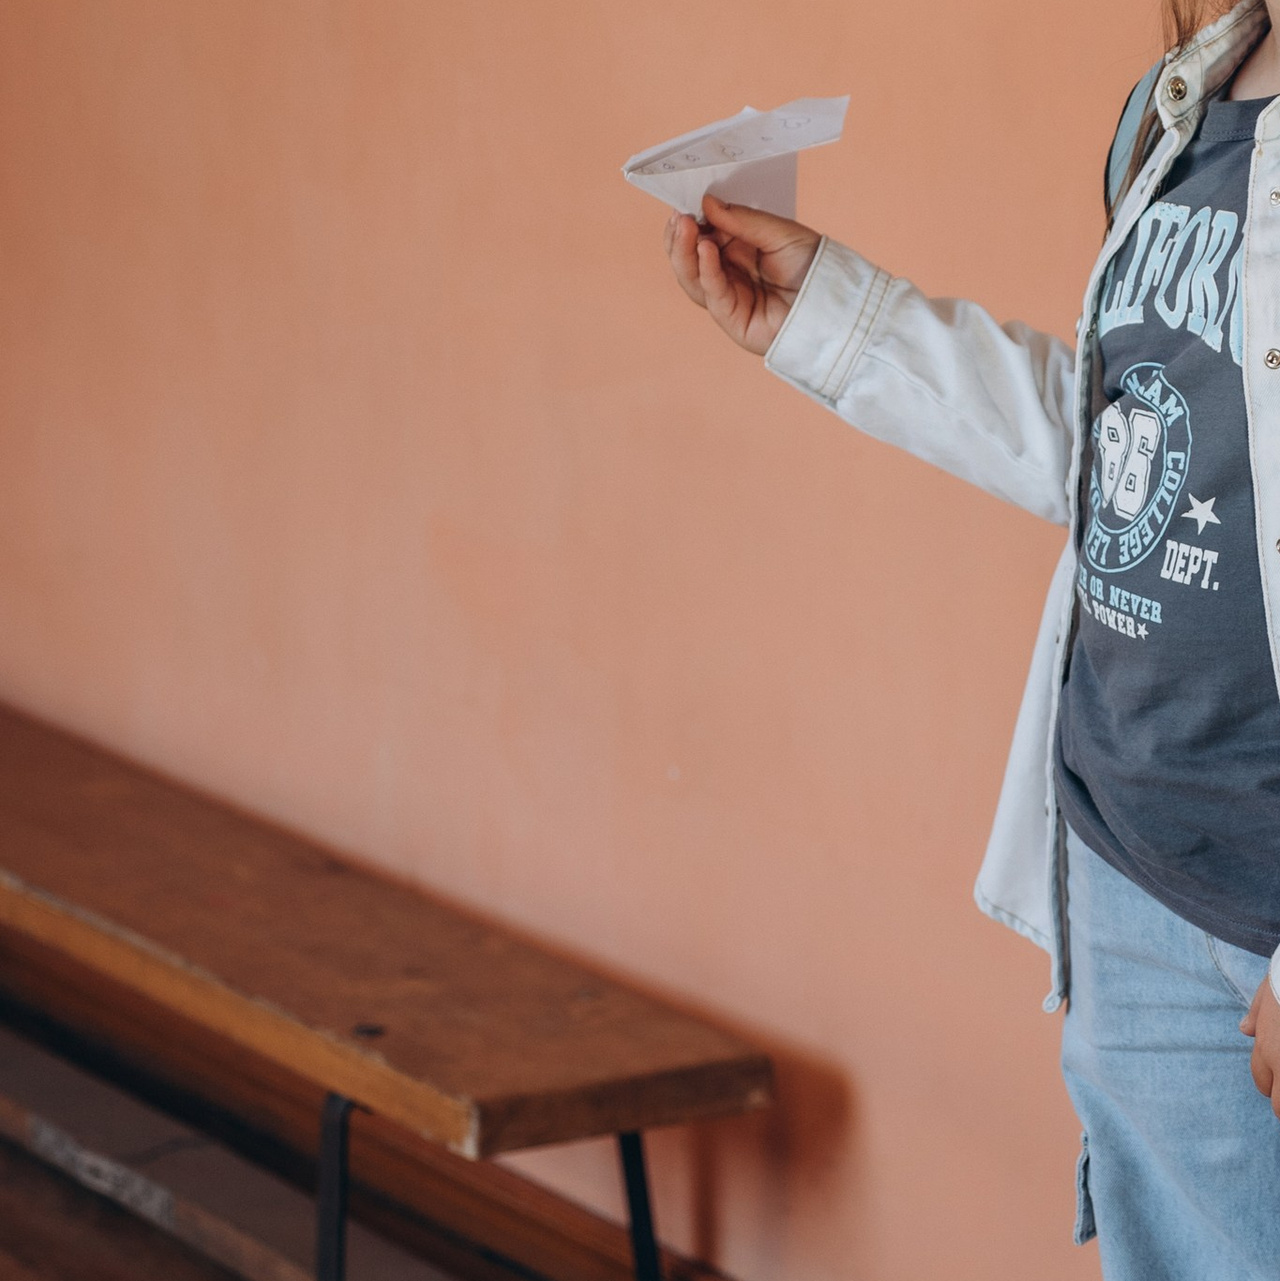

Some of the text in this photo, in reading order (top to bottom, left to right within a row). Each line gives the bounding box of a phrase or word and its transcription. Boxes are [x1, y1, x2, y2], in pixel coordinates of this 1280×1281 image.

[1118, 451, 1185, 565] COLLEGE
[1160, 539, 1220, 591] DEPT.
[1090, 575, 1104, 601] OR
[1109, 585, 1162, 624] NEVER
[1092, 600, 1137, 639] POWER
